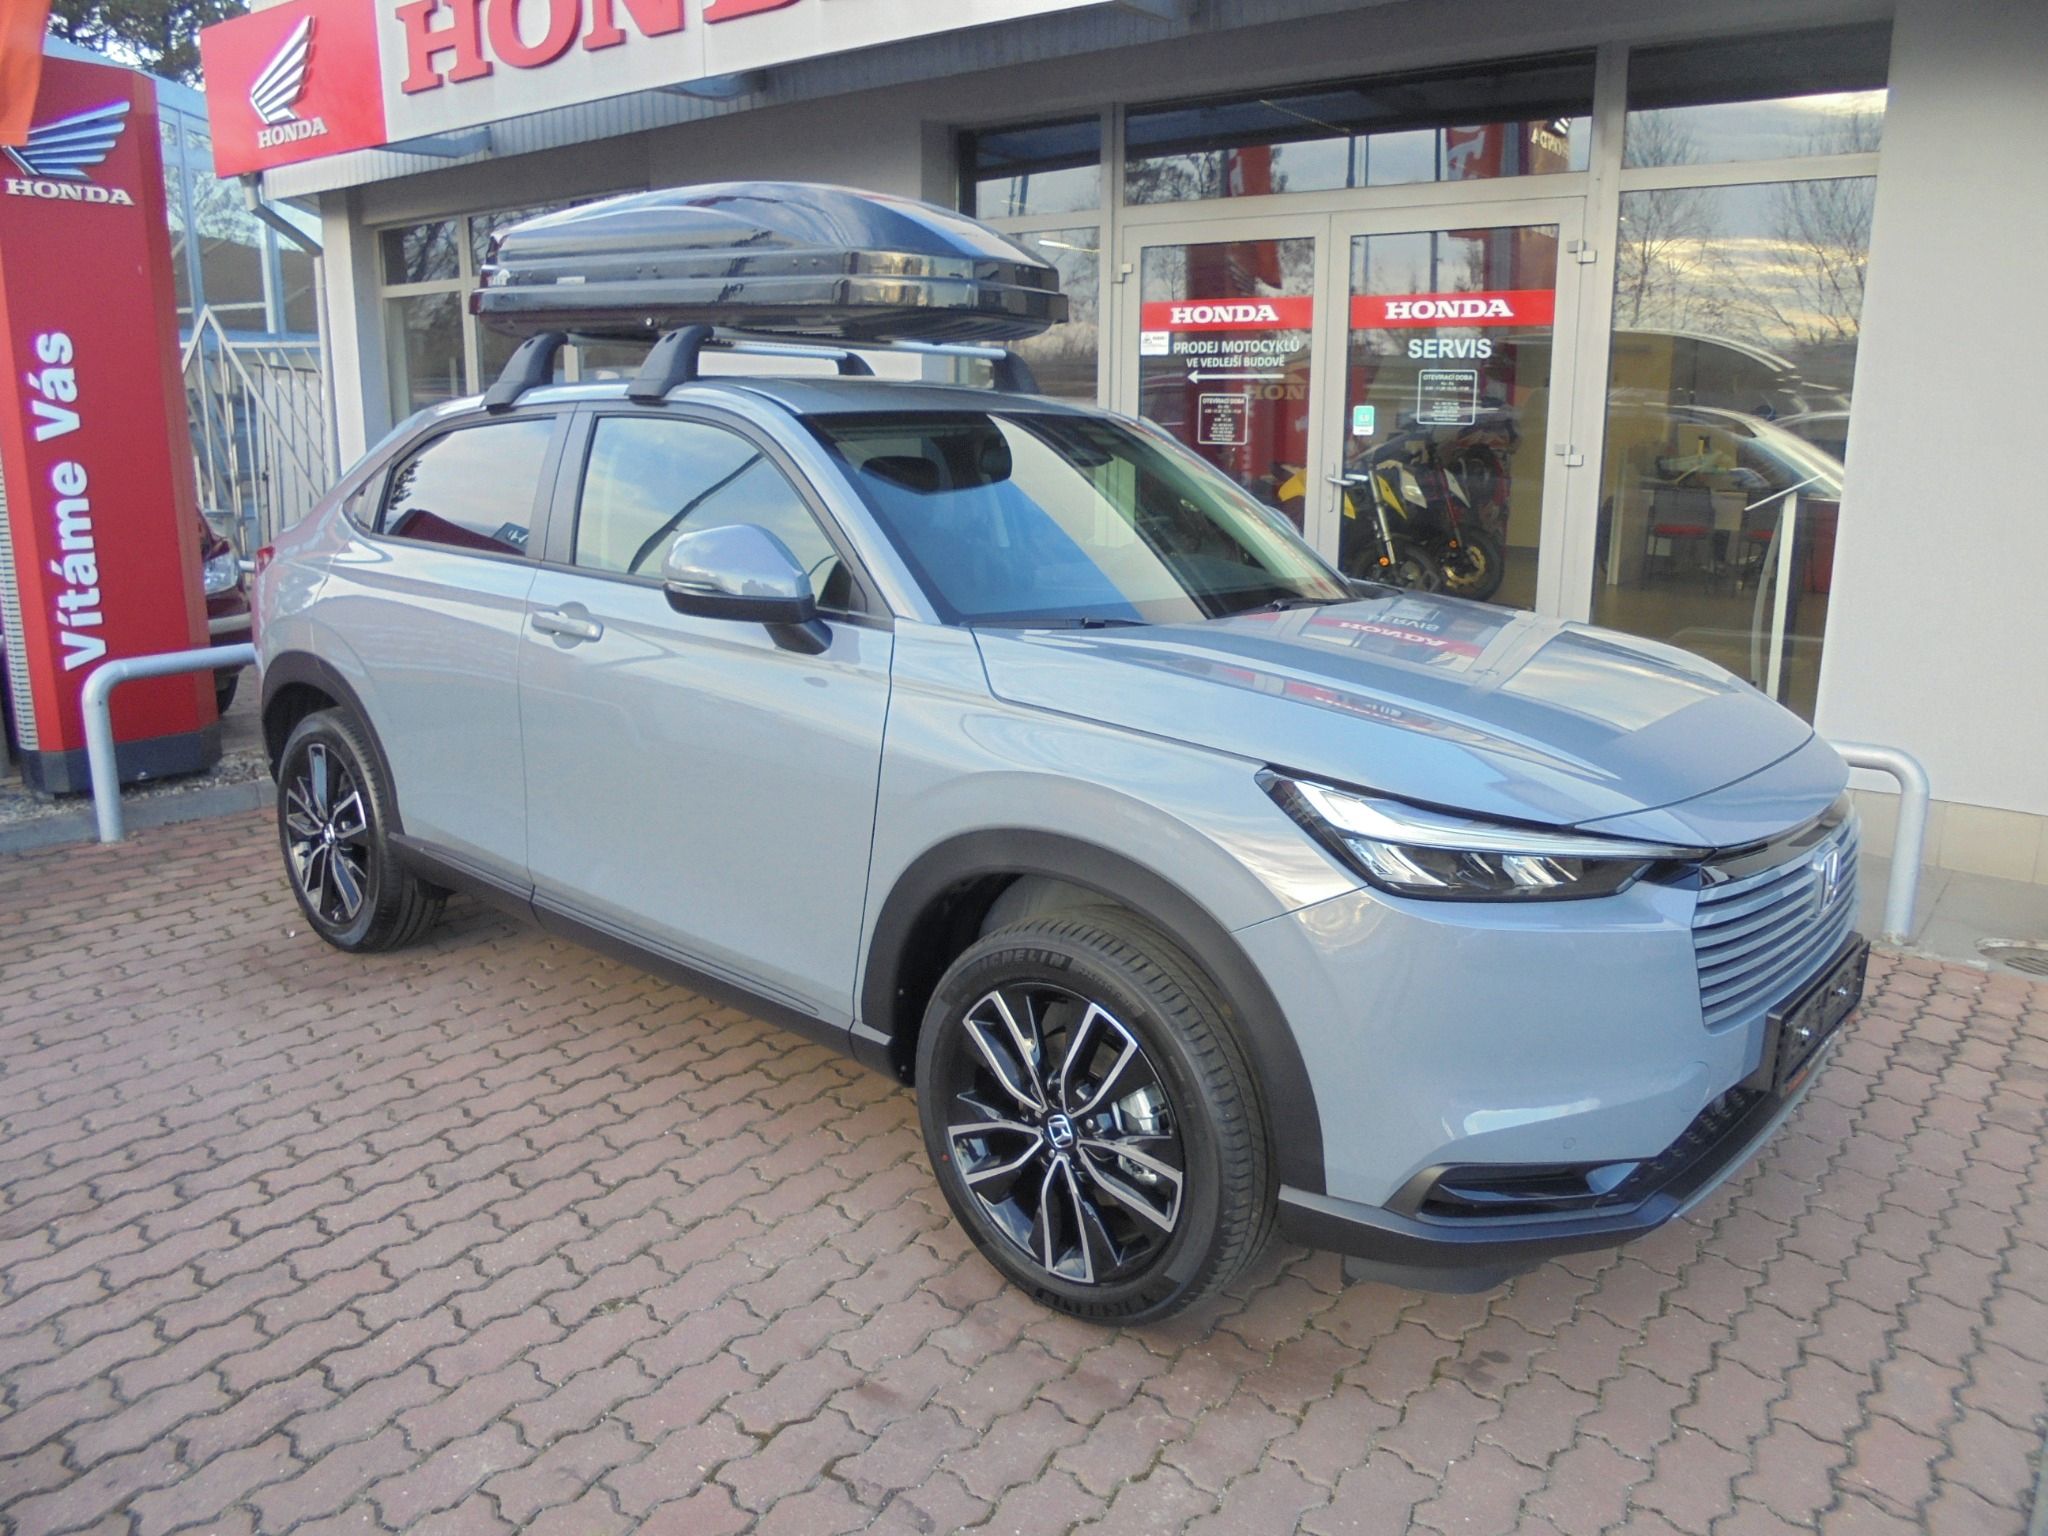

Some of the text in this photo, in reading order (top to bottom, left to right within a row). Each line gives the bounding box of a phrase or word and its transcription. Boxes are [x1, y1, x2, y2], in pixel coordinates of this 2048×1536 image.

[396, 0, 800, 95] HON
[257, 117, 328, 149] HONDA
[5, 178, 135, 206] HONDA
[1170, 305, 1279, 324] HONDA
[1384, 299, 1515, 320] HONDA
[1173, 336, 1301, 355] PRODEJ MOTOCYKLŮ
[1407, 337, 1493, 359] SERVIS
[1186, 354, 1285, 368] VE VEDLEJŠÍ BUDOVĚ
[28, 331, 107, 672] Vítáme Vás
